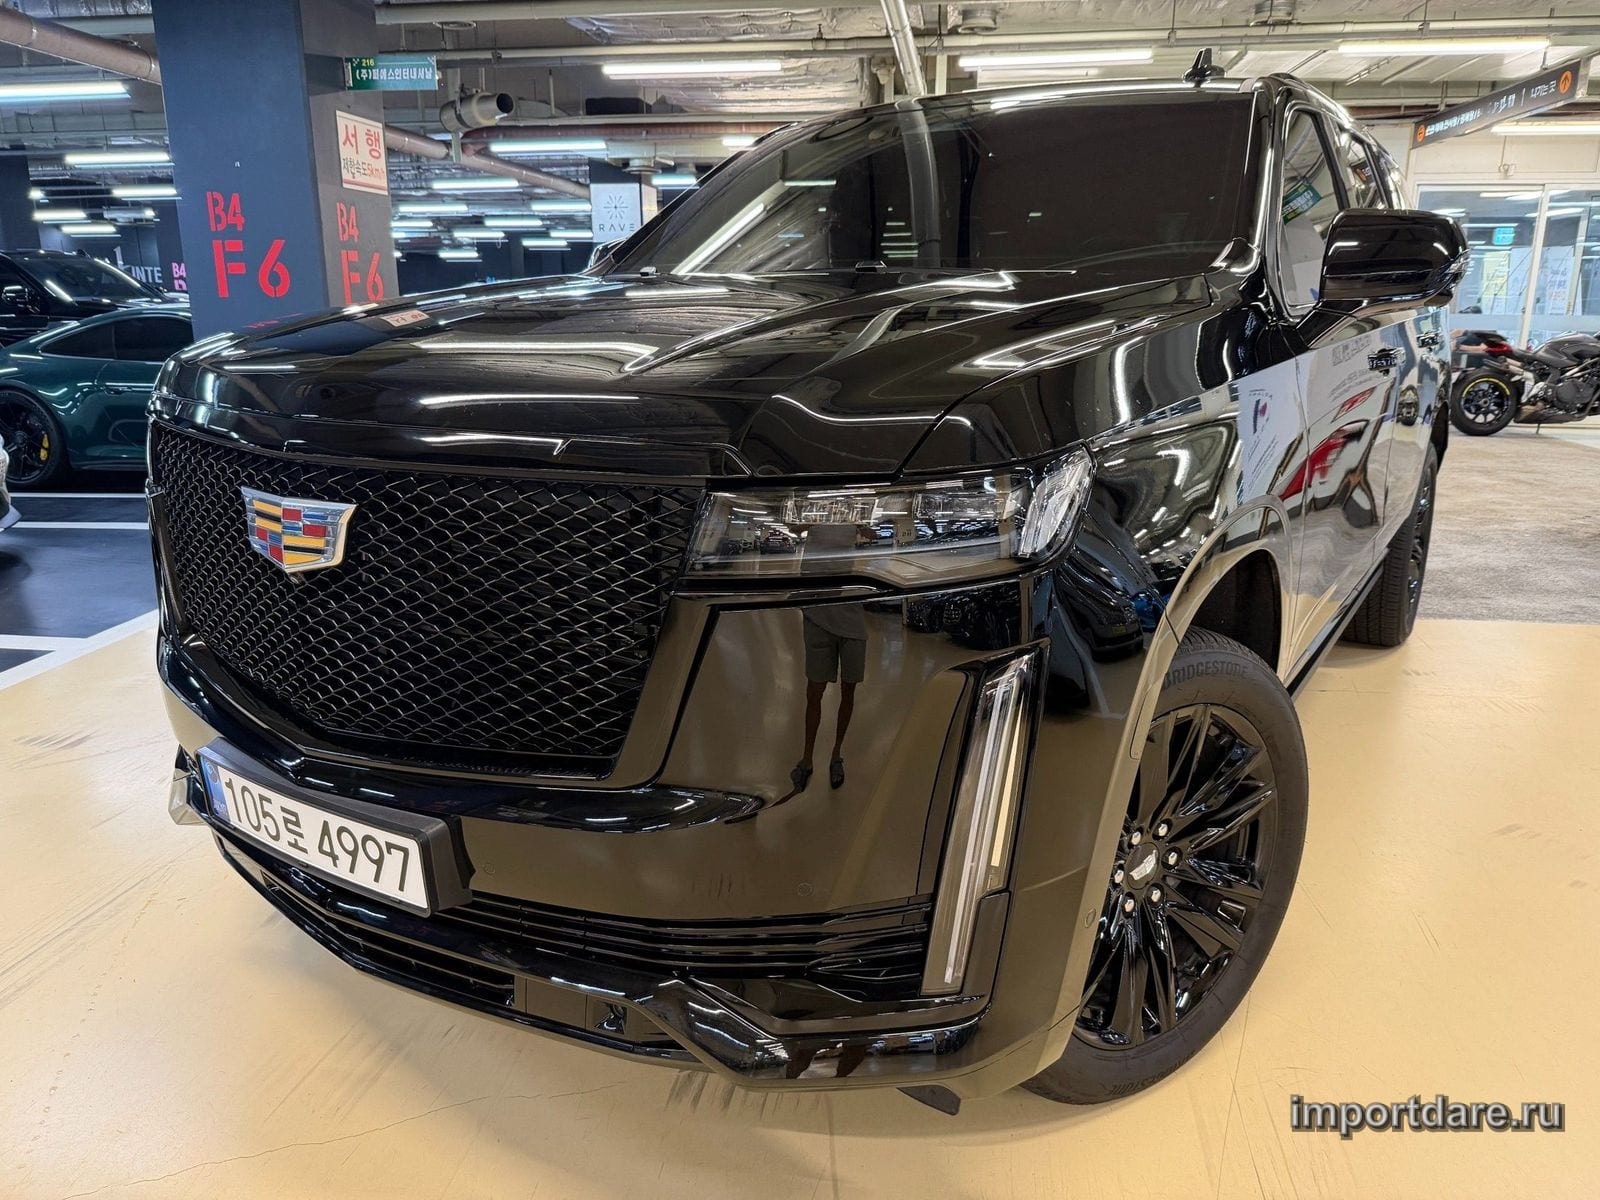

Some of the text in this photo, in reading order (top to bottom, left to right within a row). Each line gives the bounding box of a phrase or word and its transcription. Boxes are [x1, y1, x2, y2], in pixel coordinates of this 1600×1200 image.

[206, 191, 246, 232] B4
[336, 200, 360, 242] B4
[598, 223, 636, 232] RAVE
[171, 262, 187, 279] B4
[224, 777, 410, 893] 105로 4997
